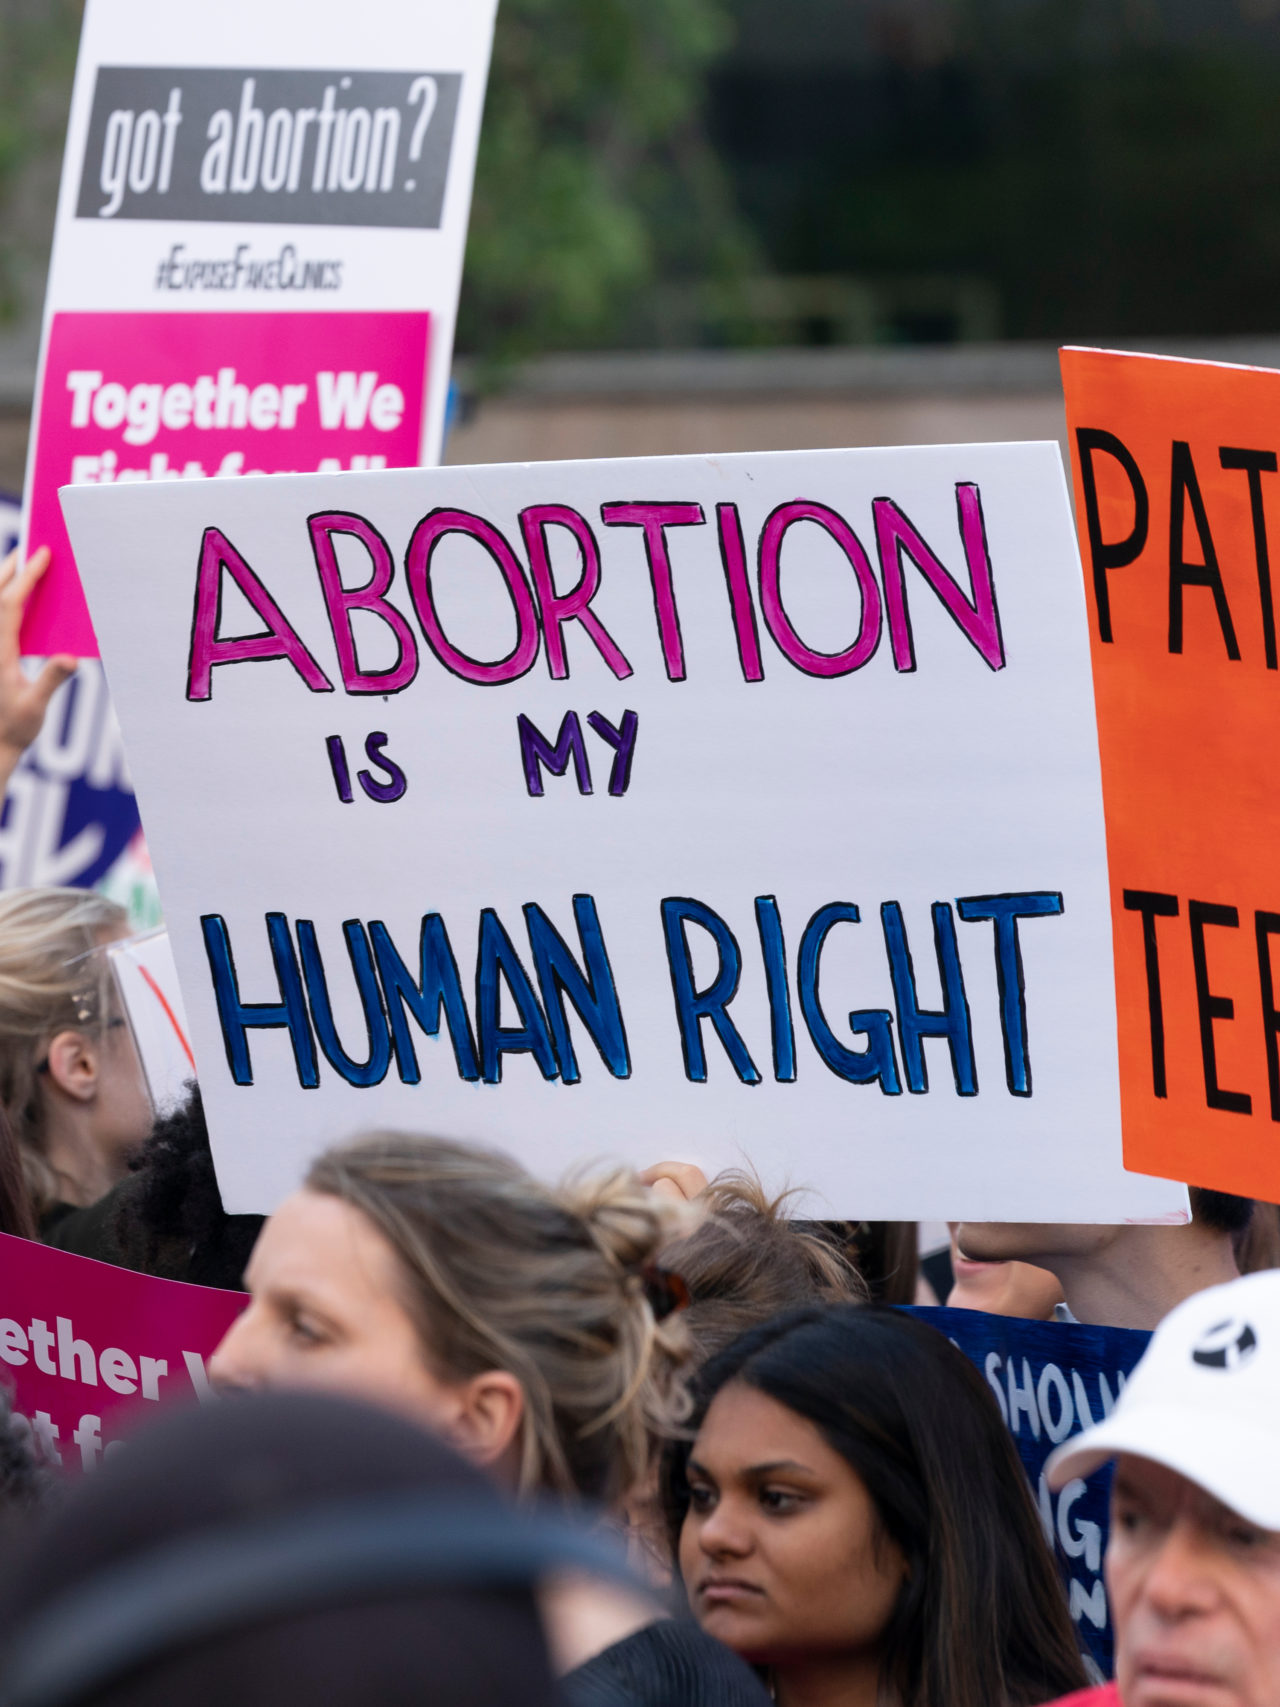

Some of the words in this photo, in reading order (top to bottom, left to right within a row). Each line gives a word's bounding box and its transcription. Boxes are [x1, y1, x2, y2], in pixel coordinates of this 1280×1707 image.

[99, 87, 183, 218] got
[200, 75, 439, 194] abortion?
[66, 368, 308, 446] Together
[316, 372, 406, 431] We
[186, 481, 1006, 702] ABORTION
[1075, 426, 1279, 671] PAT
[326, 731, 407, 804] IS
[516, 709, 639, 797] MY
[200, 893, 632, 1089] HUMAN
[660, 891, 1064, 1097] RIGHT
